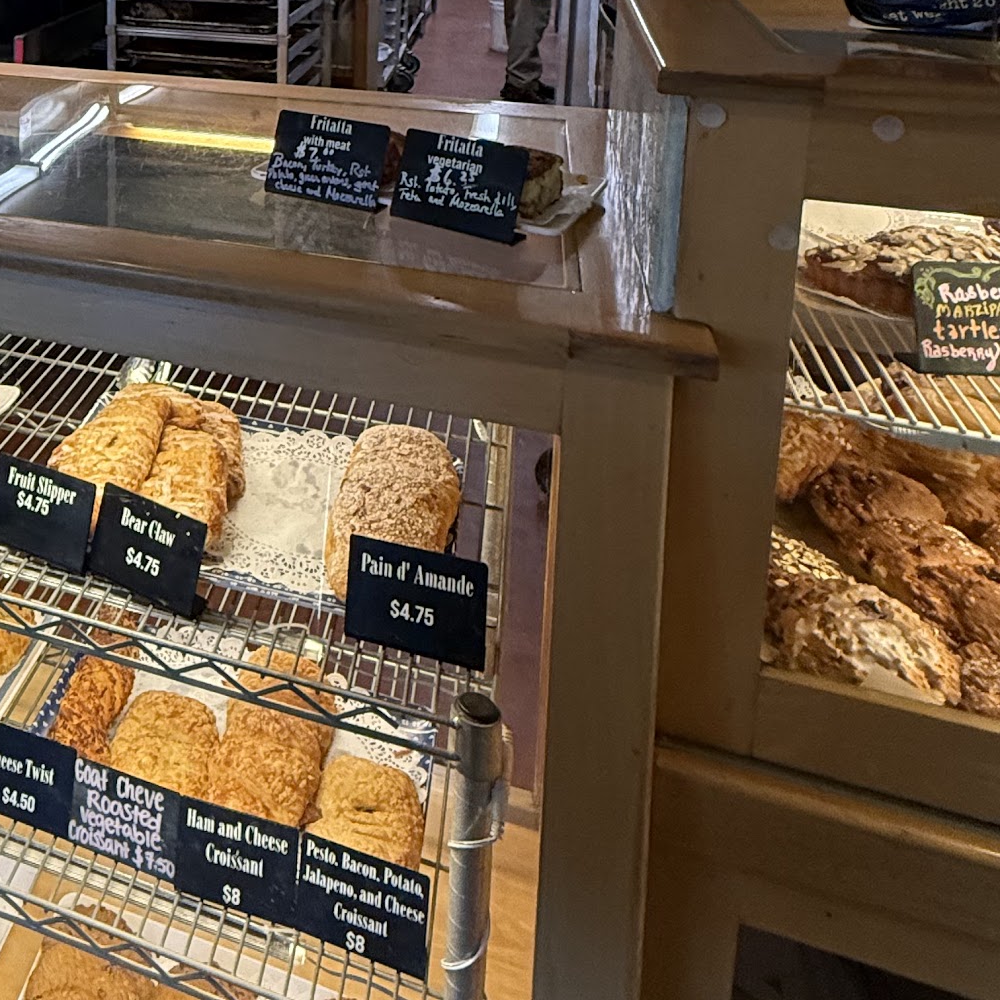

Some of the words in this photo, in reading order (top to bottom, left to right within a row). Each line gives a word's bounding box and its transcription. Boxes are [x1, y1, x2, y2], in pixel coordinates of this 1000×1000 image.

[303, 135, 325, 148] with
[325, 140, 351, 152] meat
[427, 154, 483, 174] vegetarian
[938, 283, 1000, 304] Rasbe
[933, 318, 1000, 341] tartle
[7, 465, 37, 492] Fruit
[36, 475, 77, 506] Slipper
[16, 490, 50, 517] $4.75
[120, 506, 148, 536] Bear
[148, 518, 176, 548] Claw
[125, 546, 161, 577] $4.75
[360, 552, 393, 579] Pain
[396, 560, 411, 582] d'
[413, 564, 475, 598] Amande
[389, 598, 435, 627] $4.75
[24, 758, 55, 787] Twist
[75, 758, 108, 792] Goat
[116, 775, 165, 811] Cheve
[1, 785, 36, 814] $4.50
[86, 789, 163, 834] Roasted
[186, 807, 216, 833] Ham
[217, 820, 242, 842] and
[244, 824, 289, 856] Cheese
[68, 819, 131, 860] Croissant
[132, 844, 176, 879] $7.50
[205, 842, 264, 878] Croissant
[222, 884, 241, 906] $8
[302, 864, 358, 901] Jalapeno,
[359, 888, 382, 910] and
[384, 893, 426, 925] Cheese
[383, 866, 424, 900] Potato,
[333, 901, 389, 938] Croissant
[346, 931, 366, 954] $8
